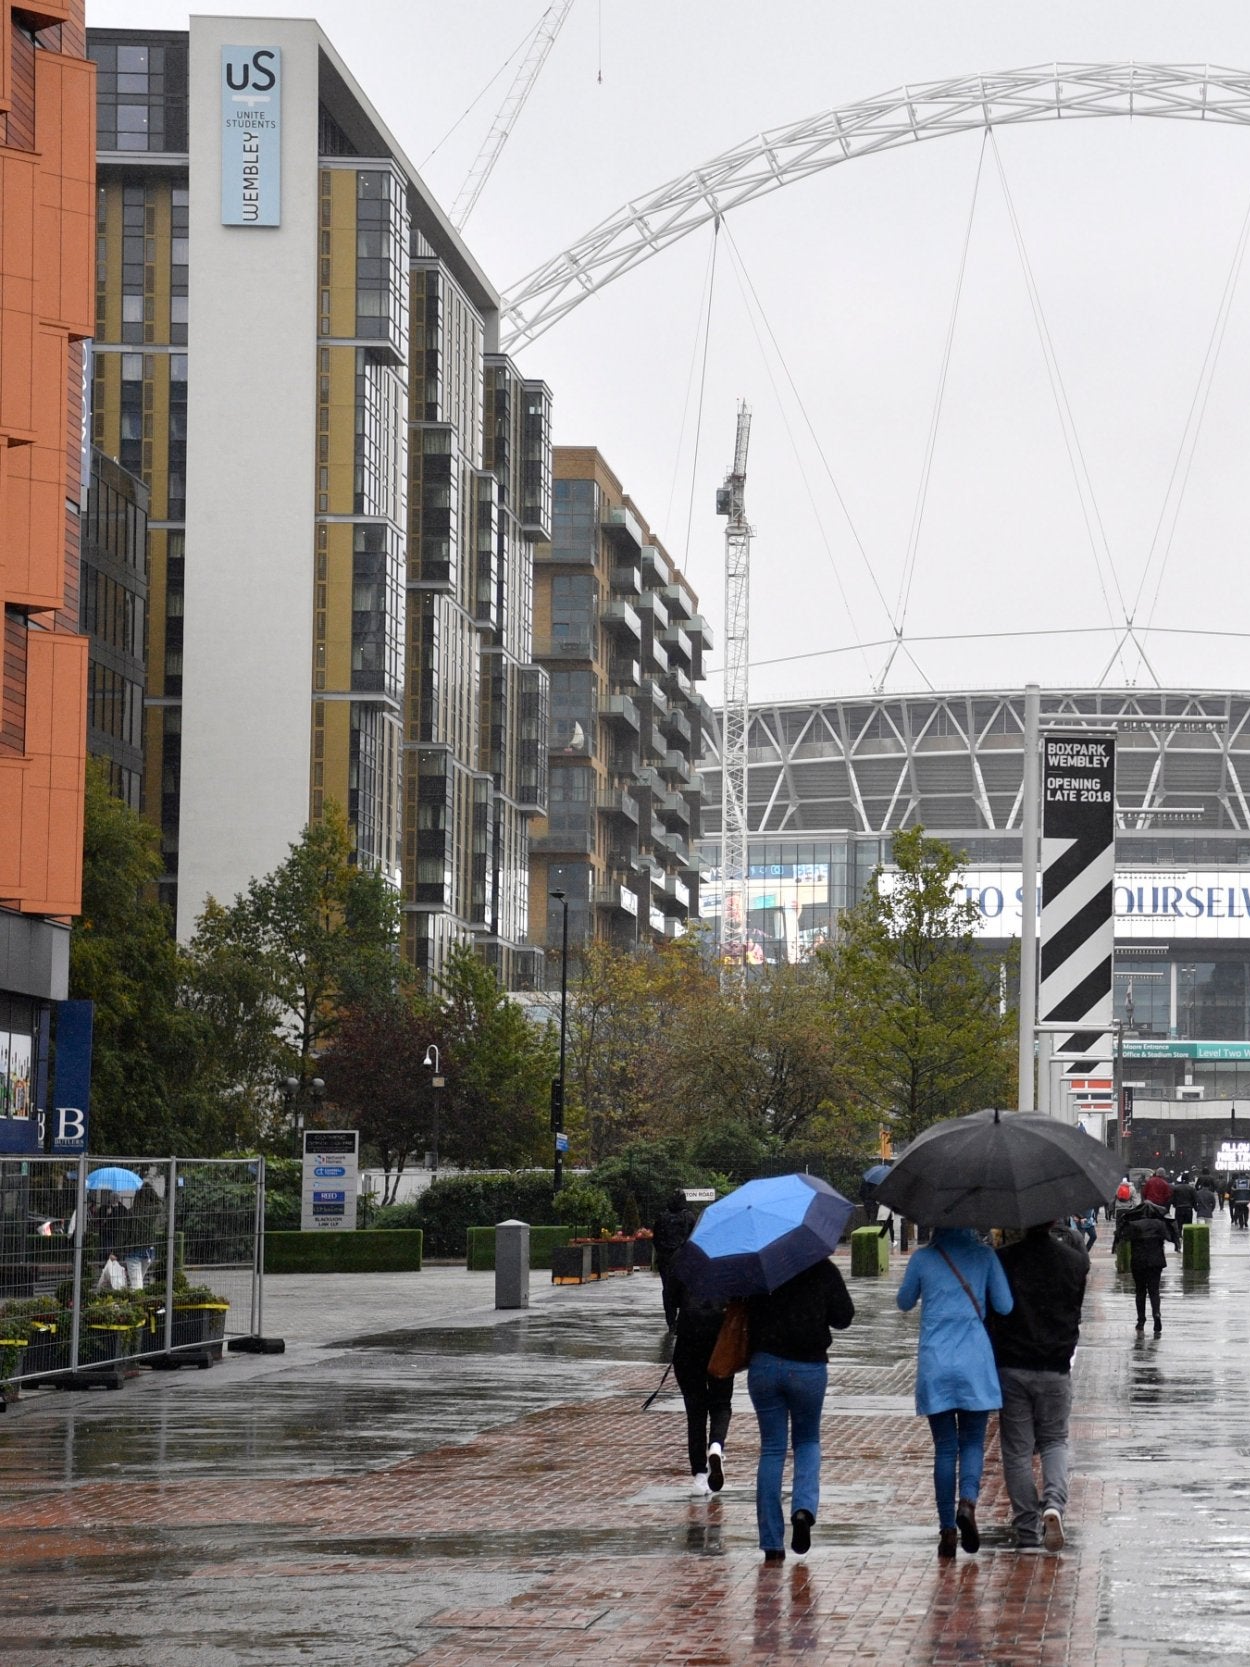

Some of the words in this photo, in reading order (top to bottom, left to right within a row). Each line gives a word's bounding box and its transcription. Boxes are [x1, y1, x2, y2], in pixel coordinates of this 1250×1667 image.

[236, 111, 265, 120] UNITE
[226, 119, 276, 129] STUDENTS
[242, 132, 259, 221] WEMBLEY
[1047, 742, 1106, 756] BOXPARK
[1047, 755, 1110, 768] WEMBLEY
[1047, 777, 1101, 790] OPENING
[1046, 789, 1077, 801] LATE
[1080, 790, 1111, 802] 2018
[1198, 1048, 1221, 1057] Level
[1223, 1048, 1242, 1057] Two
[54, 1107, 85, 1140] B
[1222, 1142, 1250, 1152] ALLOW
[1215, 1161, 1227, 1170] ON
